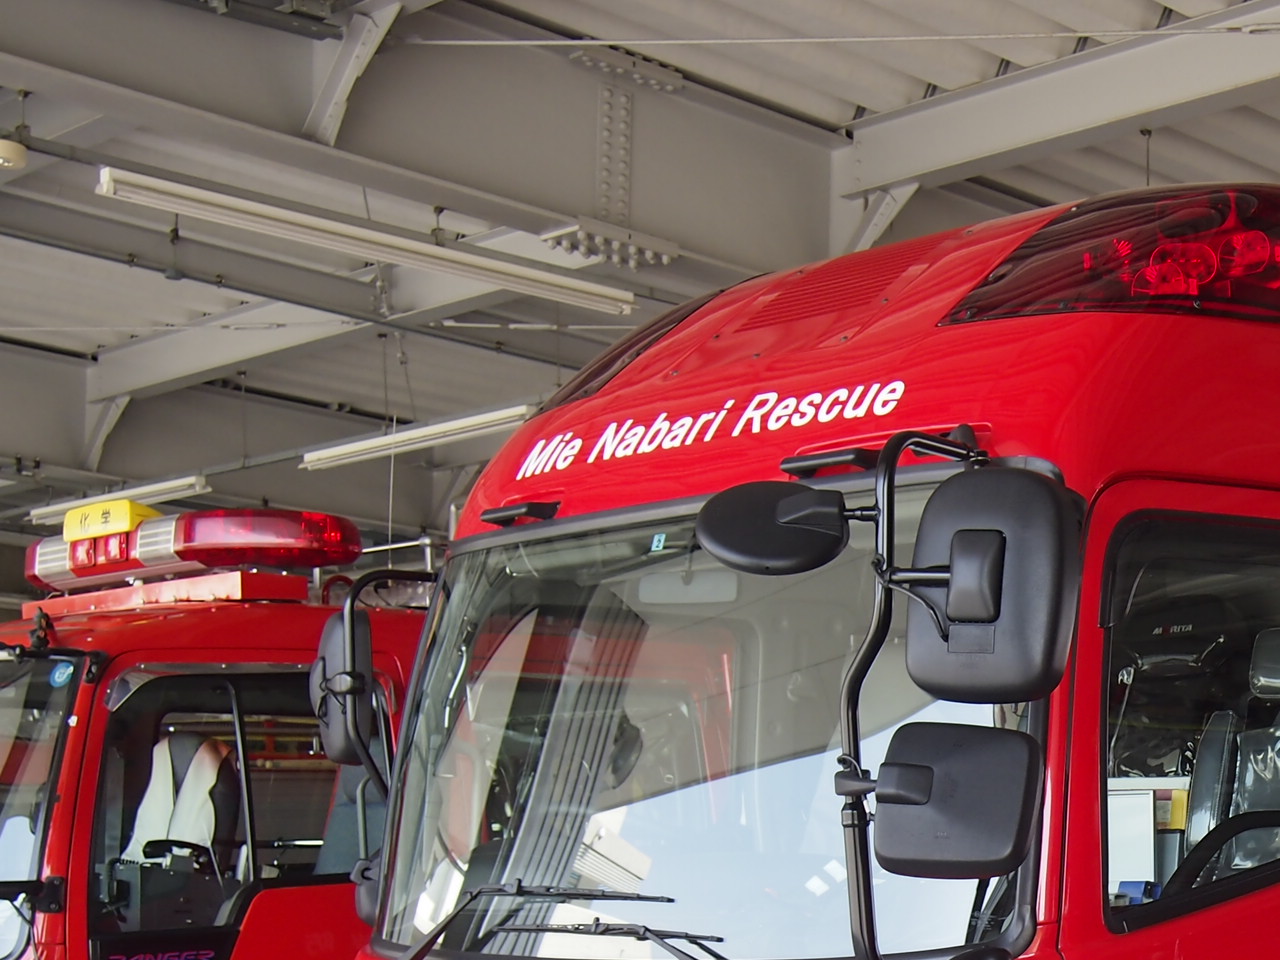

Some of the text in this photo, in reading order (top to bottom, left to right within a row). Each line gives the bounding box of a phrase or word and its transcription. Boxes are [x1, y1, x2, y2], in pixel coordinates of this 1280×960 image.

[515, 379, 906, 481] Mie Nabari Rescue
